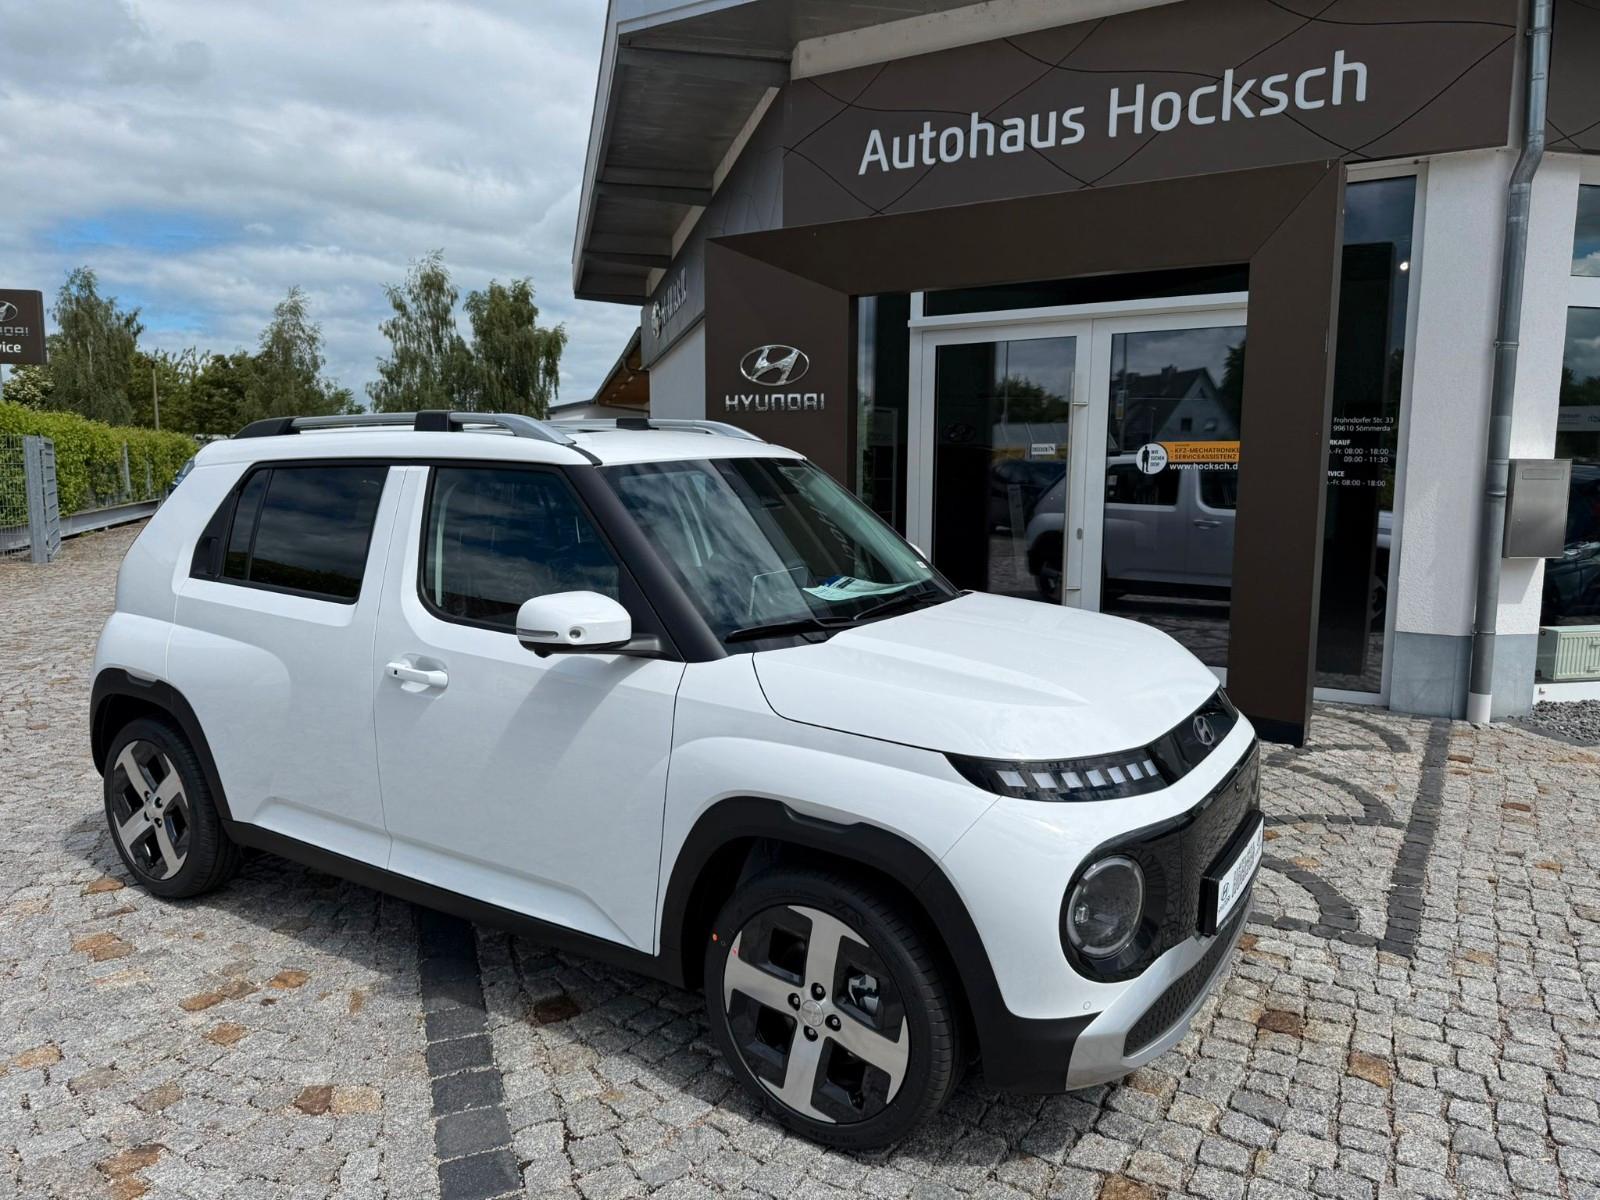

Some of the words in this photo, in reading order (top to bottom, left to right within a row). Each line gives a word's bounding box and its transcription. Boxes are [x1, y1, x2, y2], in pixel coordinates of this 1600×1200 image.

[858, 106, 1085, 175] Autohaus
[1108, 49, 1368, 138] Hocksch
[725, 393, 825, 411] HYUNDAI
[1385, 416, 1394, 424] 33
